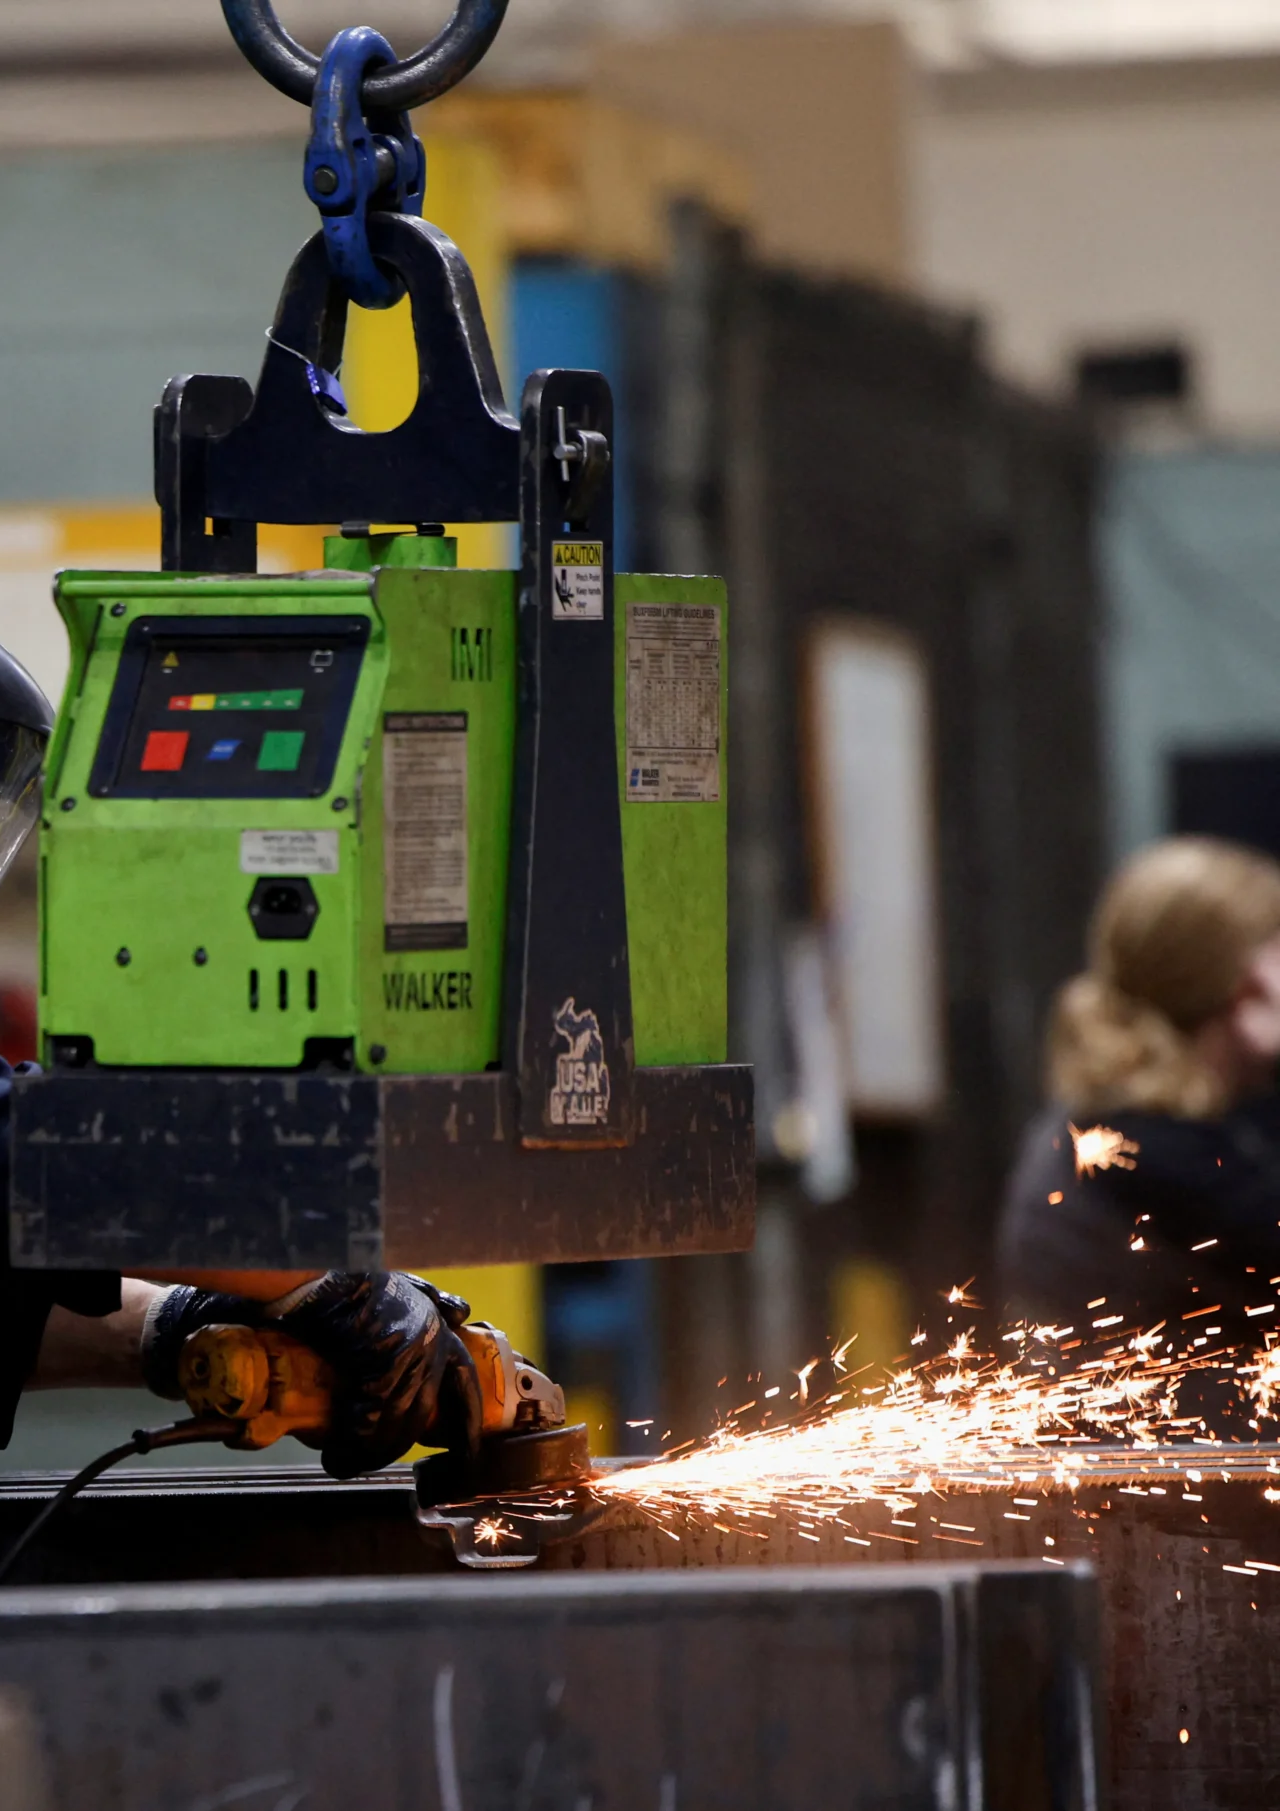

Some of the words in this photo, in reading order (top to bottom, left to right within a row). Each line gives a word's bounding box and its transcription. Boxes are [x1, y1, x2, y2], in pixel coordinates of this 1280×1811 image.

[564, 545, 600, 564] CAUTION
[684, 608, 715, 620] GUIDELINES
[383, 972, 473, 1011] WALKER
[559, 1060, 601, 1093] USA
